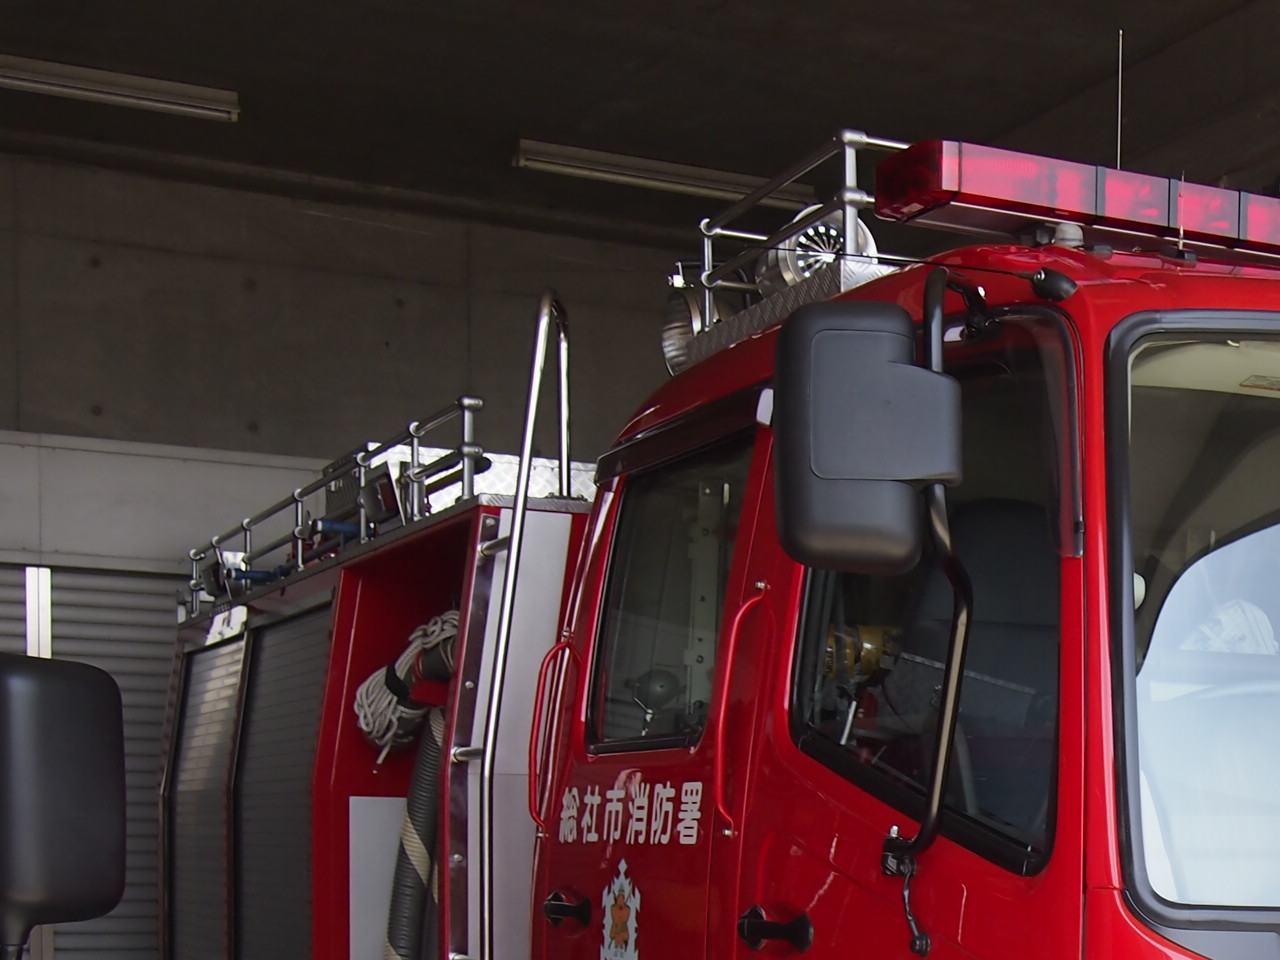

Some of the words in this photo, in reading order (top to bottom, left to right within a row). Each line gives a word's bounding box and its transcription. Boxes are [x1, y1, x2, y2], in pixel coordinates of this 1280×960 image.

[558, 781, 703, 845] 総社市消防署
